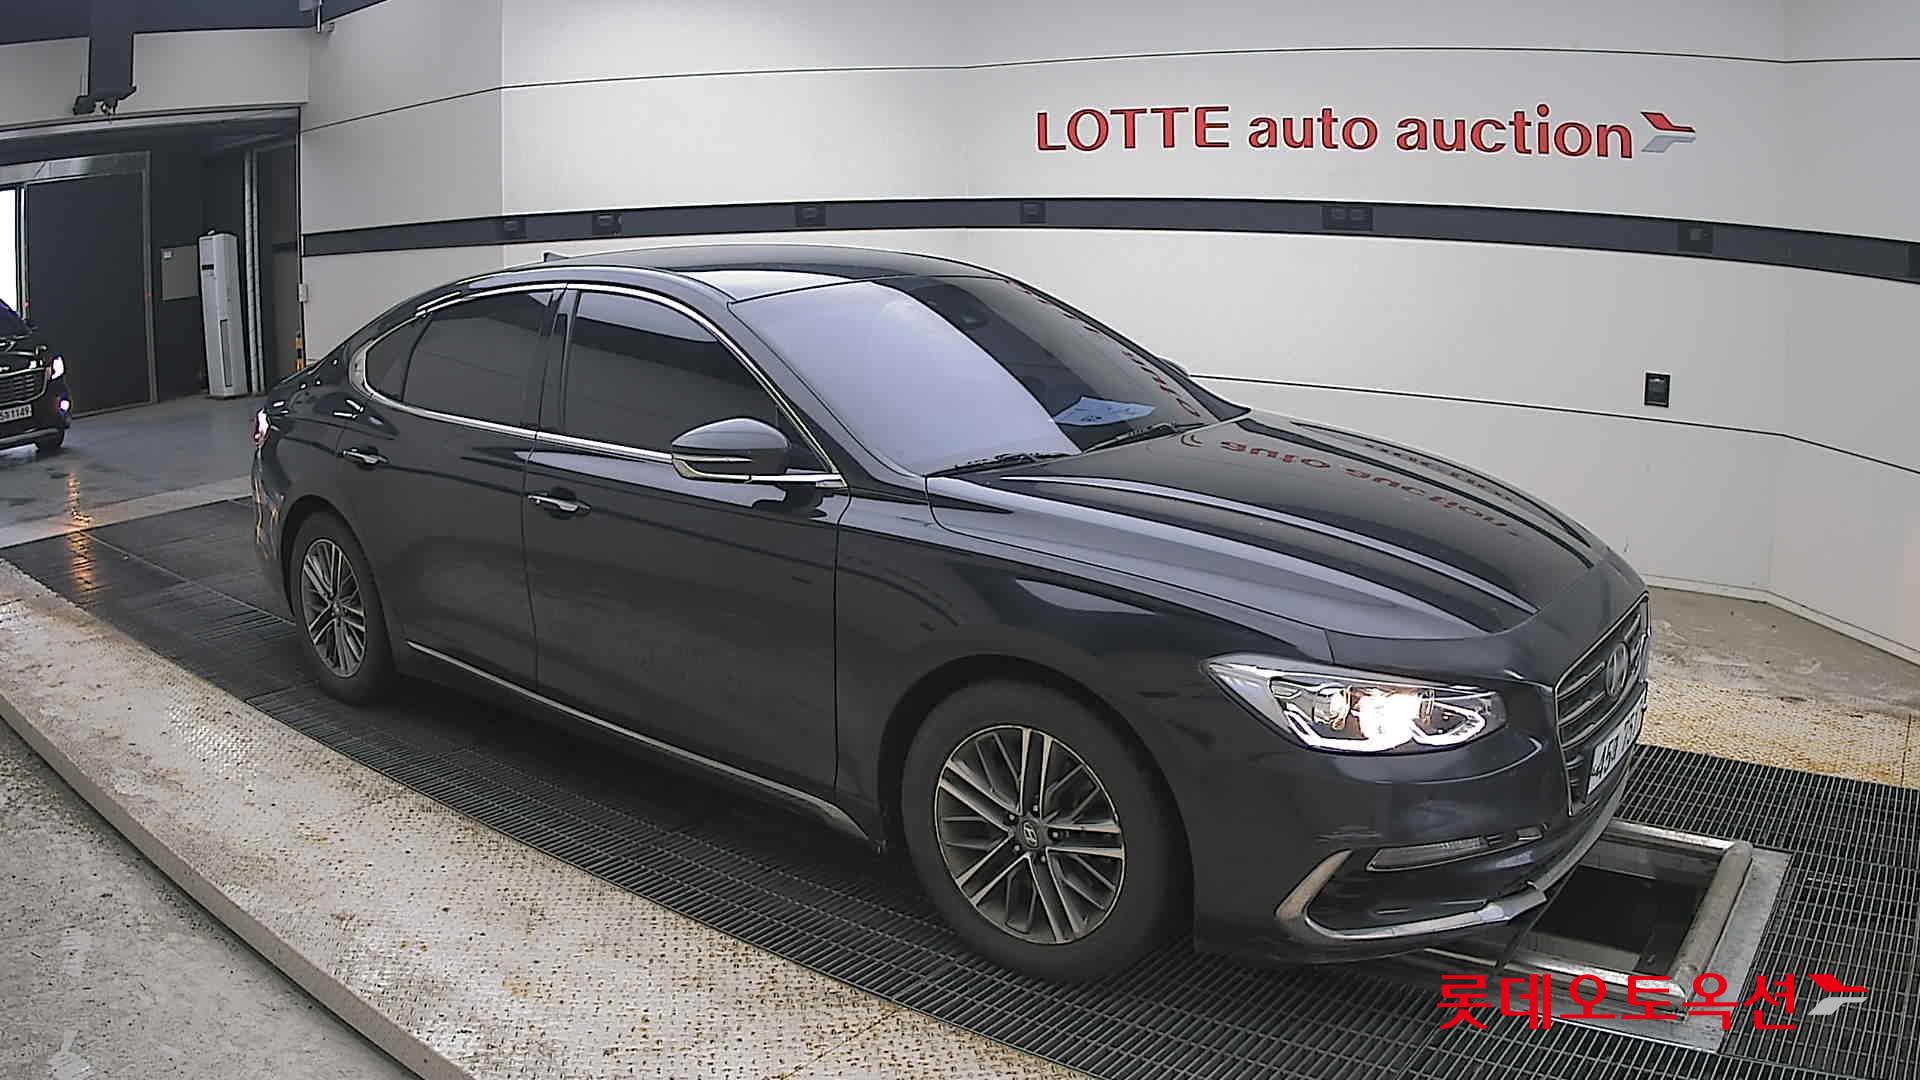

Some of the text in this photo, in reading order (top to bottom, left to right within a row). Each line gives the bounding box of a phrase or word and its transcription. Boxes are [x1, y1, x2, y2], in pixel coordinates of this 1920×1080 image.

[1036, 103, 1634, 159] LOTTE auto auction
